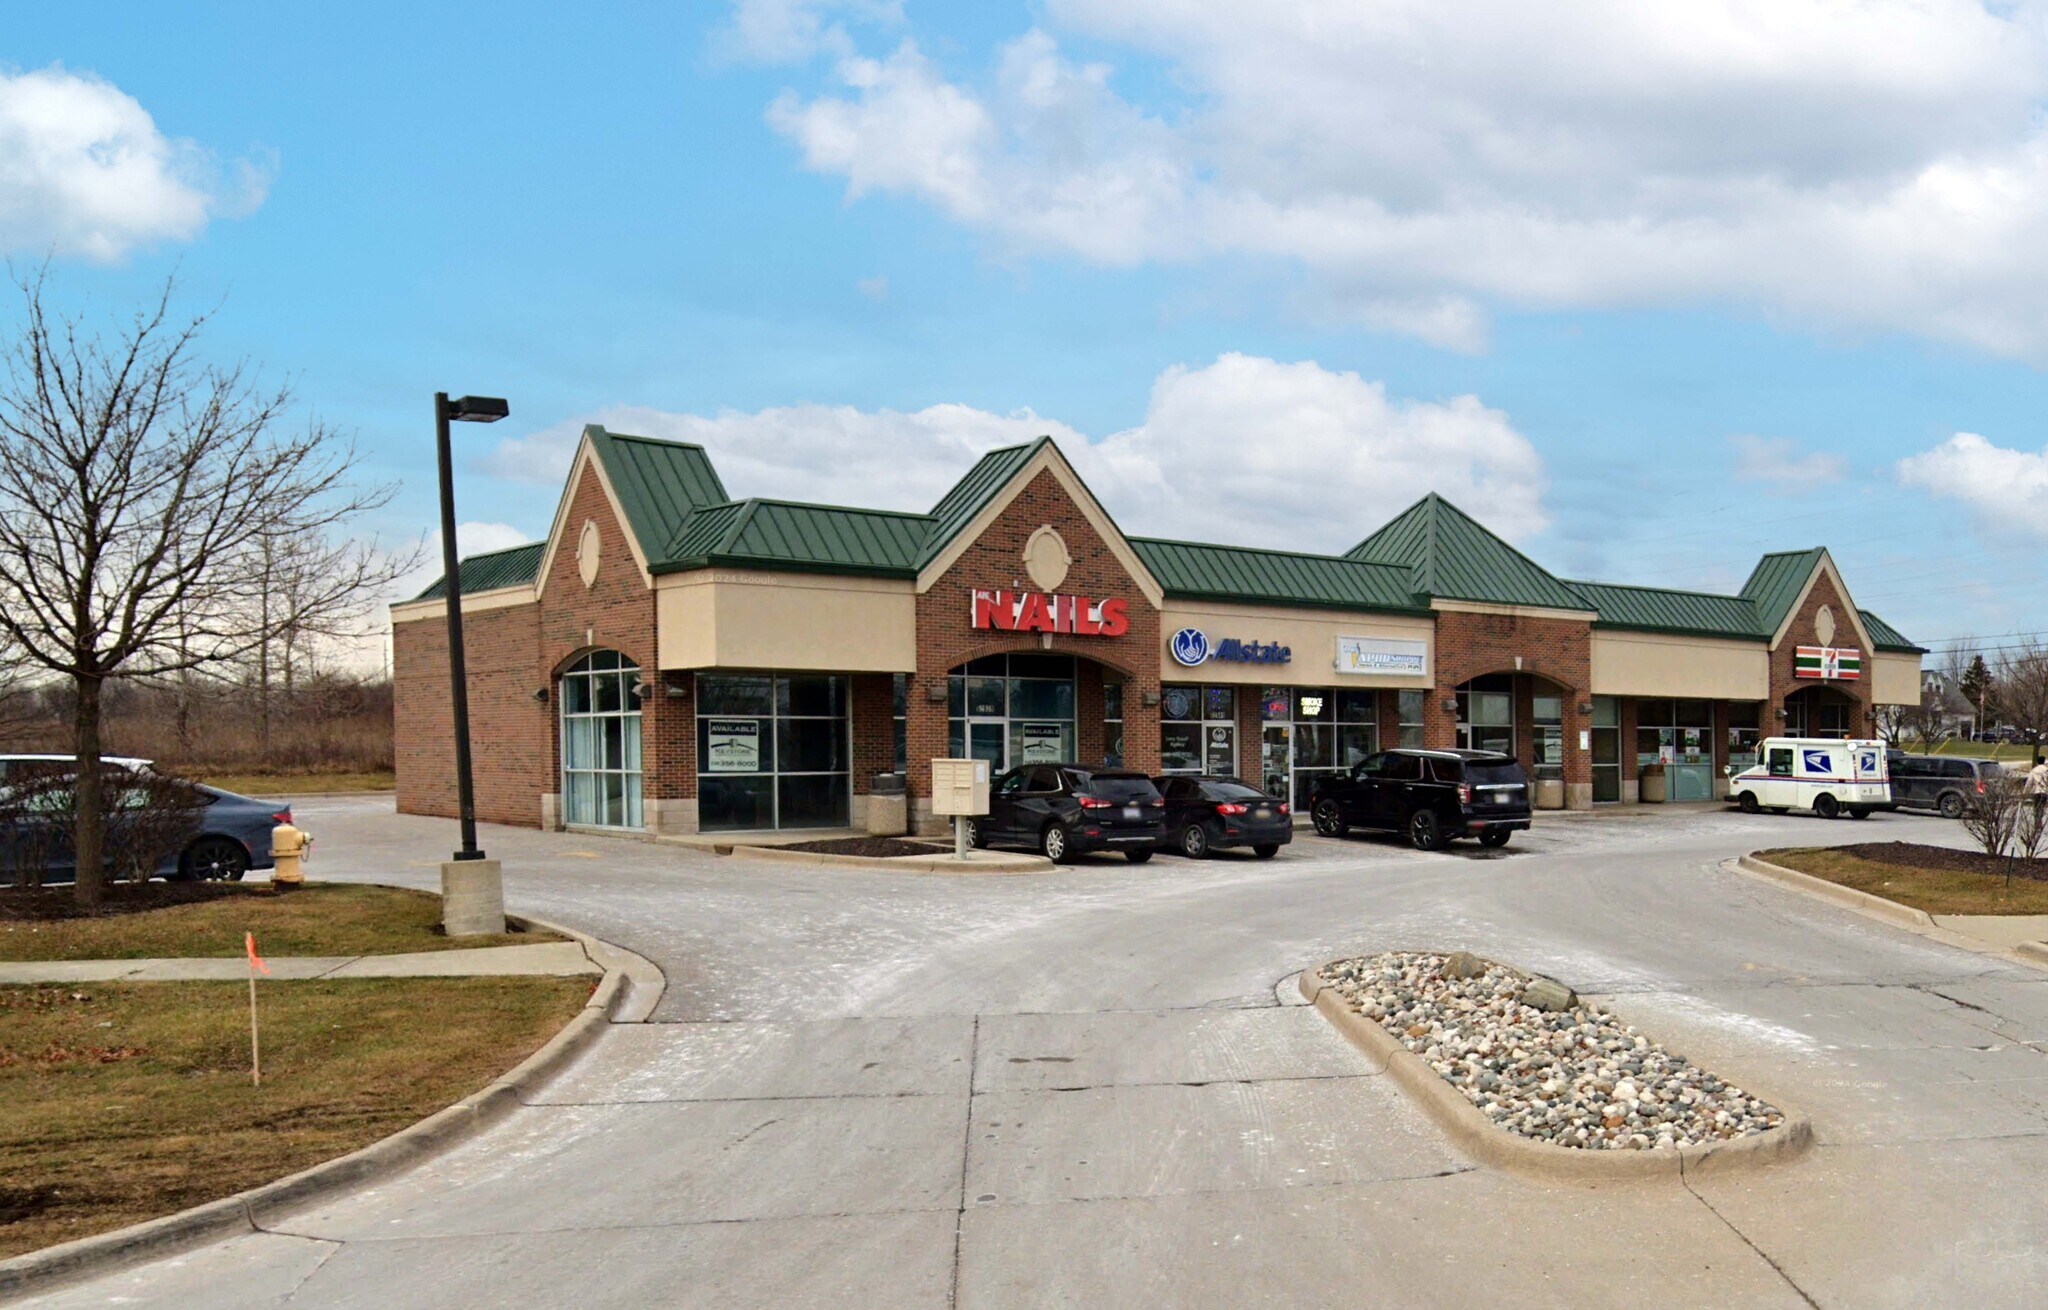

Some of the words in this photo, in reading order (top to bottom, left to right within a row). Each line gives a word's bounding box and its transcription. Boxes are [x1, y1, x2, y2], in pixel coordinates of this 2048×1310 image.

[972, 589, 1129, 636] NAILS
[1213, 638, 1291, 664] Allstate
[1301, 697, 1323, 707] SMOKE
[1302, 706, 1320, 716] SHOP
